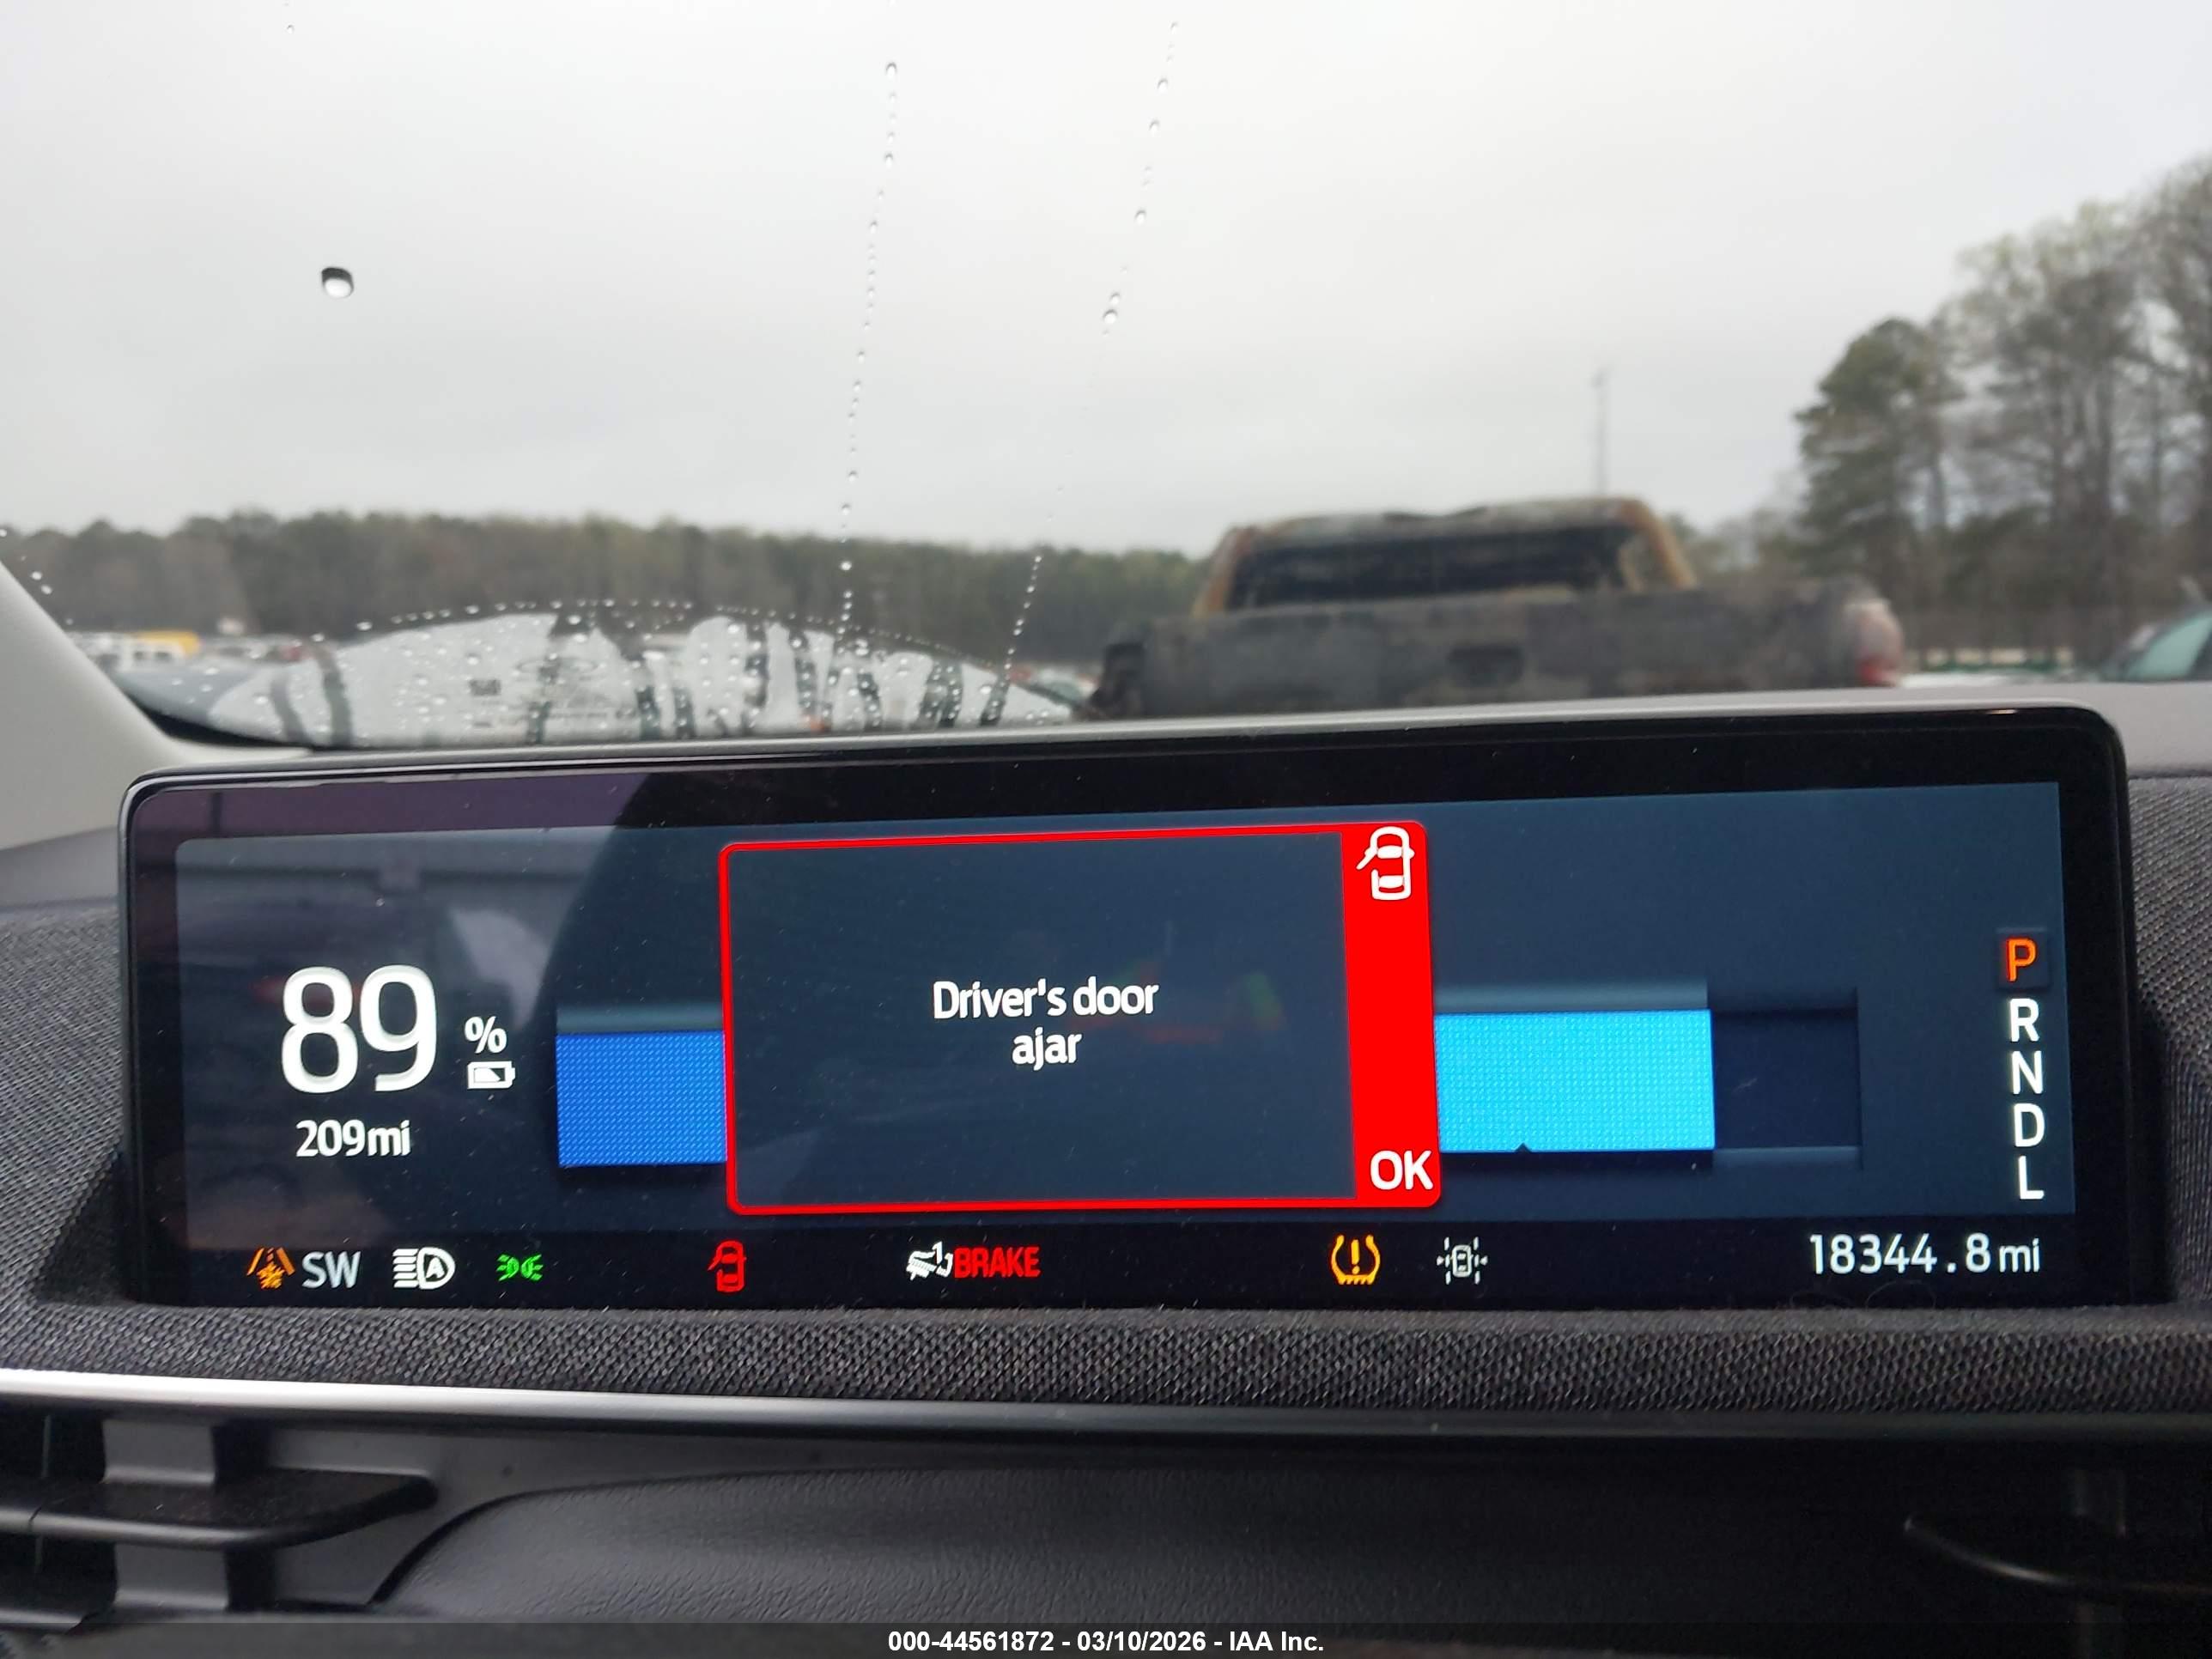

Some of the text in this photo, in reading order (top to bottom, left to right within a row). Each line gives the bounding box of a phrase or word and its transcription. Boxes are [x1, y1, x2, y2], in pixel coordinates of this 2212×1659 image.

[932, 975, 1159, 1020] Driver's door
[281, 963, 508, 1095] 89 %
[1011, 1026, 1083, 1072] ajar
[2005, 938, 2045, 1200] P R N D L
[1370, 1150, 1434, 1191] OK
[301, 1250, 362, 1290] SW
[954, 1247, 1042, 1279] BRAKE
[1808, 1232, 2041, 1275] 18344.8 mi
